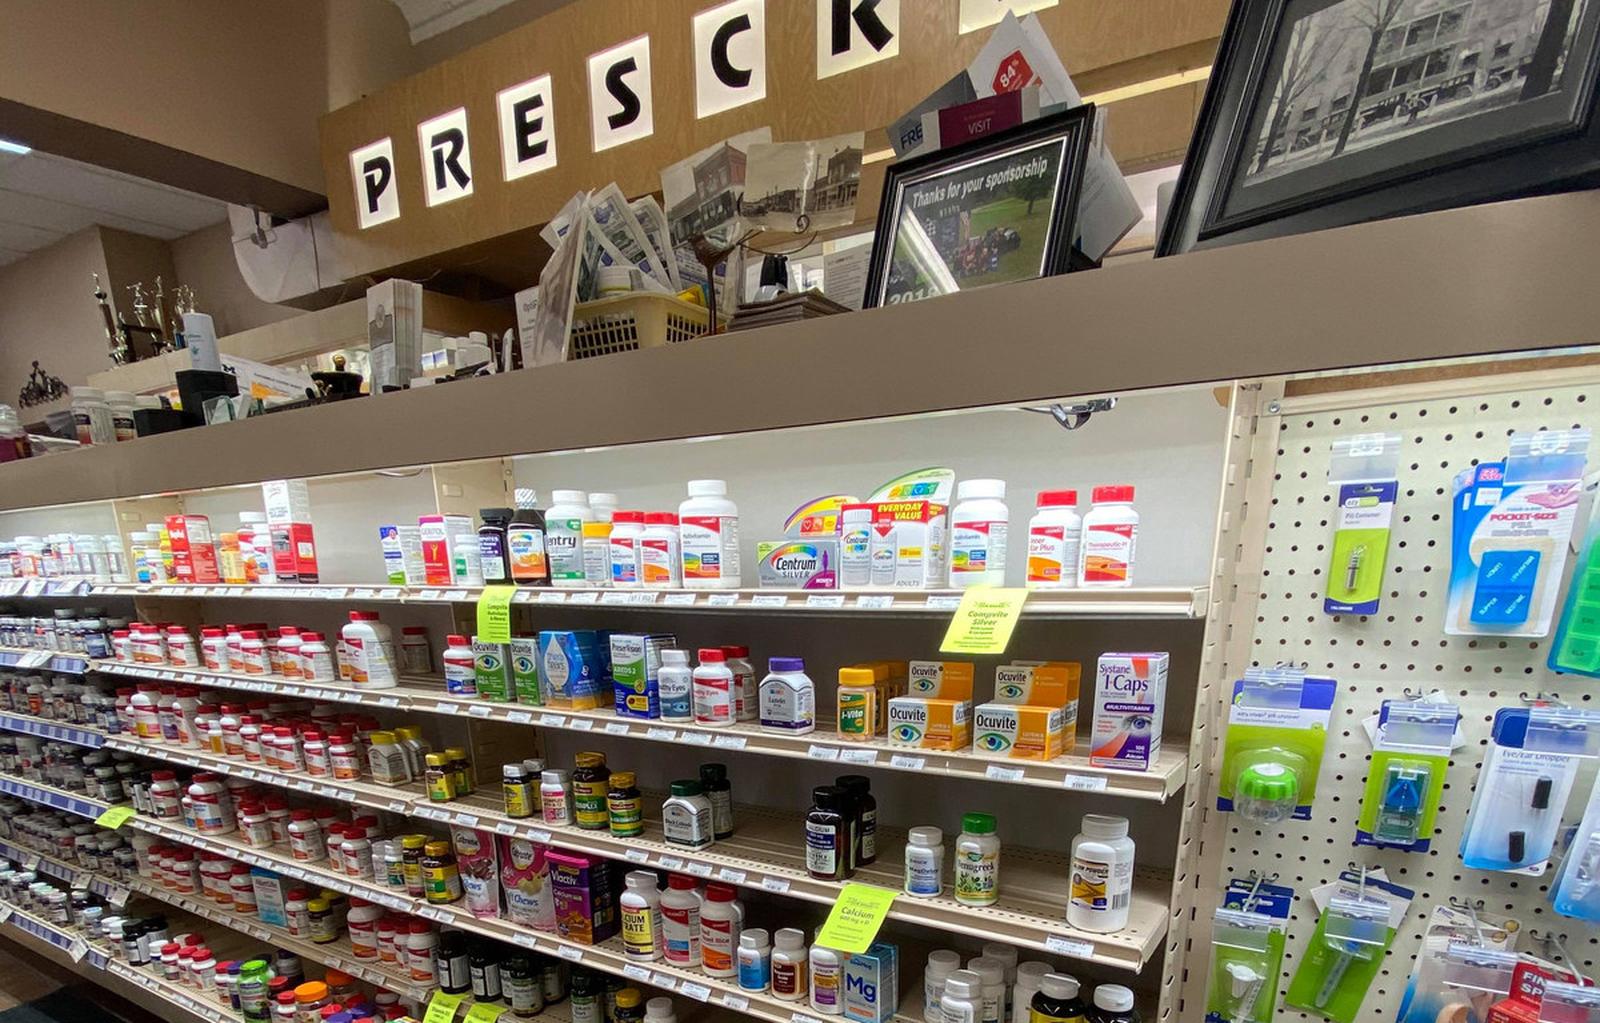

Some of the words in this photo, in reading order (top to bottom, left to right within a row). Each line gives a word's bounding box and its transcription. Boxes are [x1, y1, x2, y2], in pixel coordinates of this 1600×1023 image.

[968, 118, 992, 135] VISIT
[912, 185, 946, 208] Thanks
[947, 180, 961, 199] for
[961, 174, 984, 199] your
[985, 156, 1048, 192] sponsorship
[878, 502, 925, 514] EVERYDAY
[895, 511, 923, 521] VALUE
[1490, 512, 1558, 522] POCKET-SIZE
[776, 557, 818, 571] Centrum
[896, 579, 921, 587] ADULTS
[911, 667, 938, 678] Ocuvite
[1100, 663, 1130, 676] Systane
[997, 671, 1027, 682] Ocuvite
[1105, 703, 1151, 712] MULTIVITAMIN
[889, 706, 927, 722] Ocuvite
[976, 714, 1017, 730] Ocuvite
[1502, 749, 1534, 761] Eye/Ear
[841, 906, 875, 920] Calcium
[846, 972, 877, 1003] Mg
